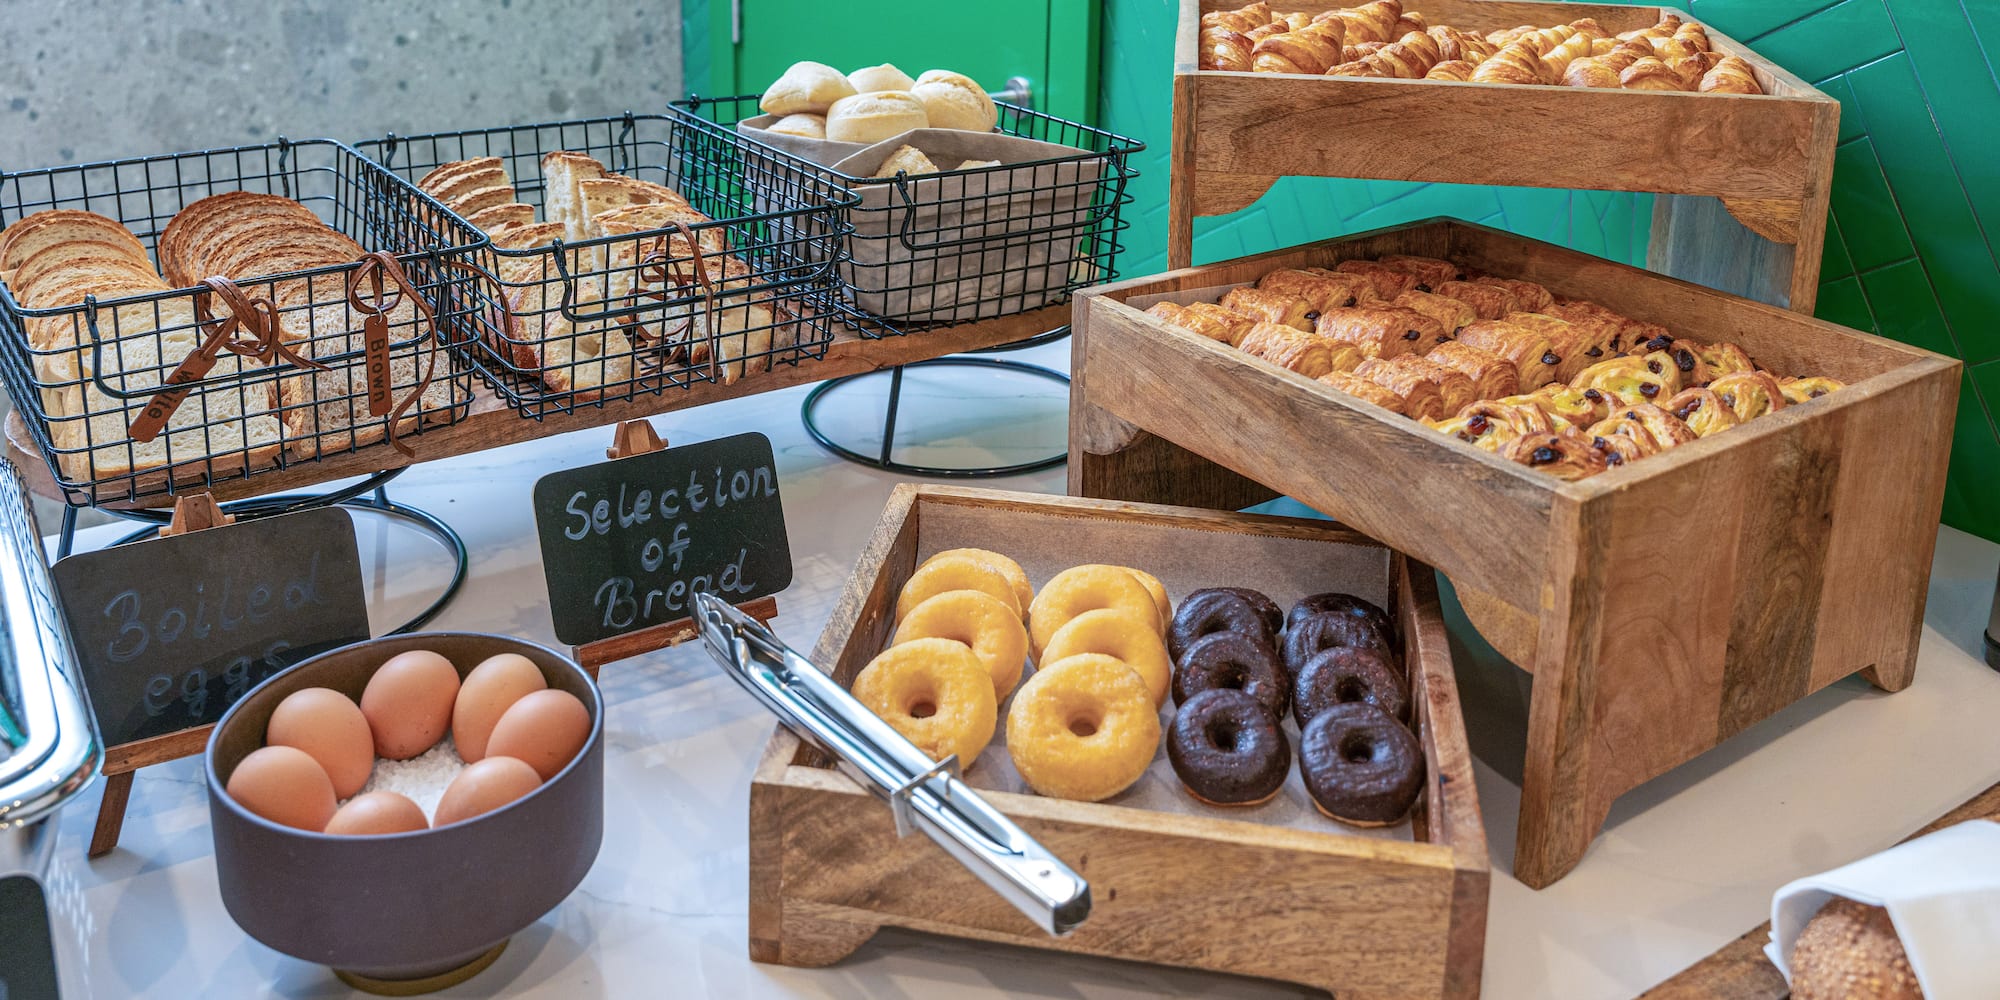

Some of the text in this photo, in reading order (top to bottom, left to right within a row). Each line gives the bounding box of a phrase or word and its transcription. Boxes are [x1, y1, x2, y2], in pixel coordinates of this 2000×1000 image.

[370, 338, 385, 403] Brown
[564, 466, 776, 541] Selection
[641, 523, 690, 573] of
[104, 551, 320, 662] Boiled
[594, 548, 757, 629] Bread
